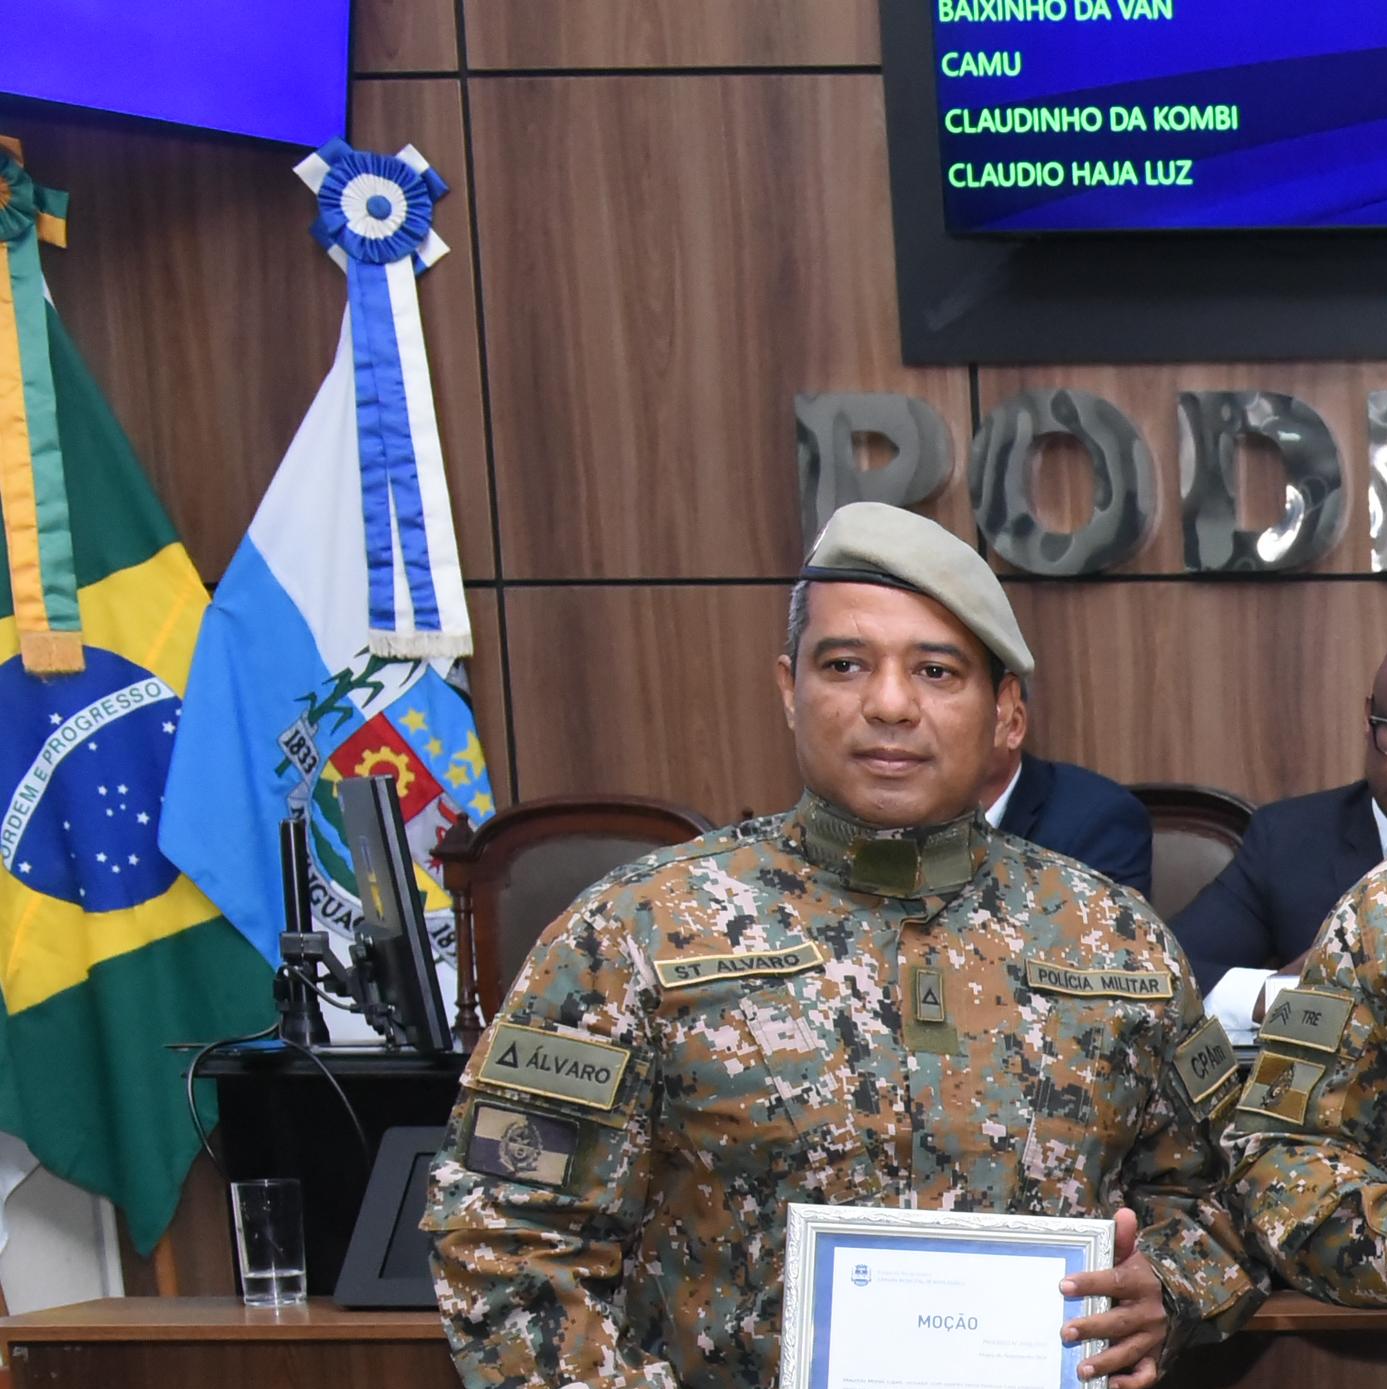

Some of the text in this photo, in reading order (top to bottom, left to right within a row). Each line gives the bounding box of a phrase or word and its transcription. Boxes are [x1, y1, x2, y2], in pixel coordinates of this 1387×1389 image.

[938, 0, 1173, 22] BAIXINHO DA VAN
[942, 52, 1021, 77] CAMU
[945, 105, 1238, 133] CLAUDINHO DA KOMBI
[949, 160, 1193, 187] CLAUDIO HAJA LUZ
[283, 729, 317, 774] 1833
[0, 681, 162, 860] ORDEM E PROGRESSO
[674, 954, 800, 979] ST ALVARO
[1038, 968, 1159, 993] POLÍCIA MILITAR
[1301, 1010, 1322, 1027] TRE
[526, 1046, 611, 1084] ÁLVARO
[917, 1312, 979, 1332] MOÇÃO
